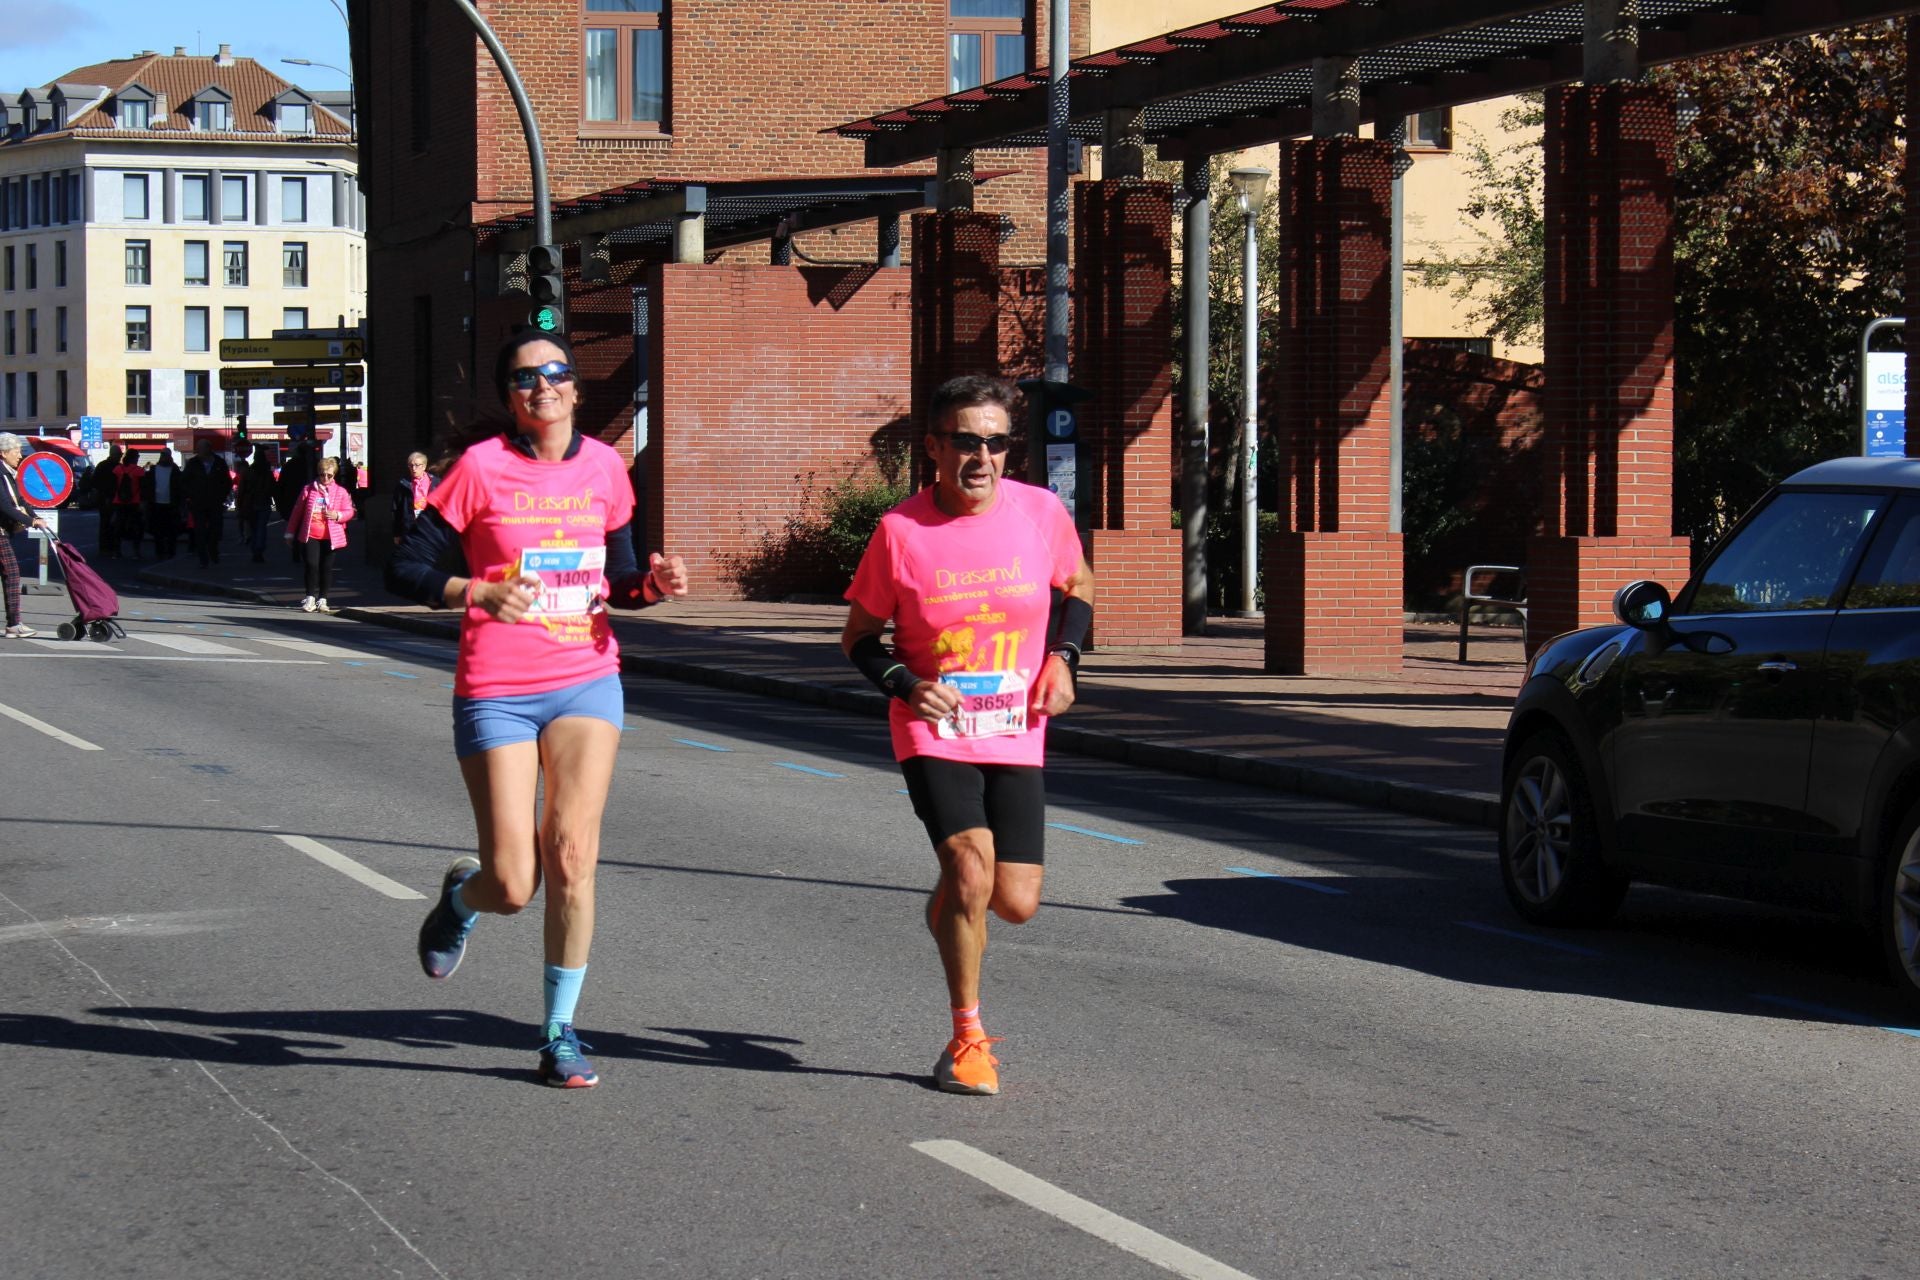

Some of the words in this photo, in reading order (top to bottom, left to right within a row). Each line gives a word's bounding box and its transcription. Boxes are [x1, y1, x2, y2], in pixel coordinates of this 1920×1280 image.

[1055, 410, 1072, 436] P
[119, 432, 147, 440] BURGER
[151, 432, 170, 440] KING
[251, 433, 279, 441] BURGER
[554, 571, 591, 588] 1400
[972, 693, 1015, 711] 3652
